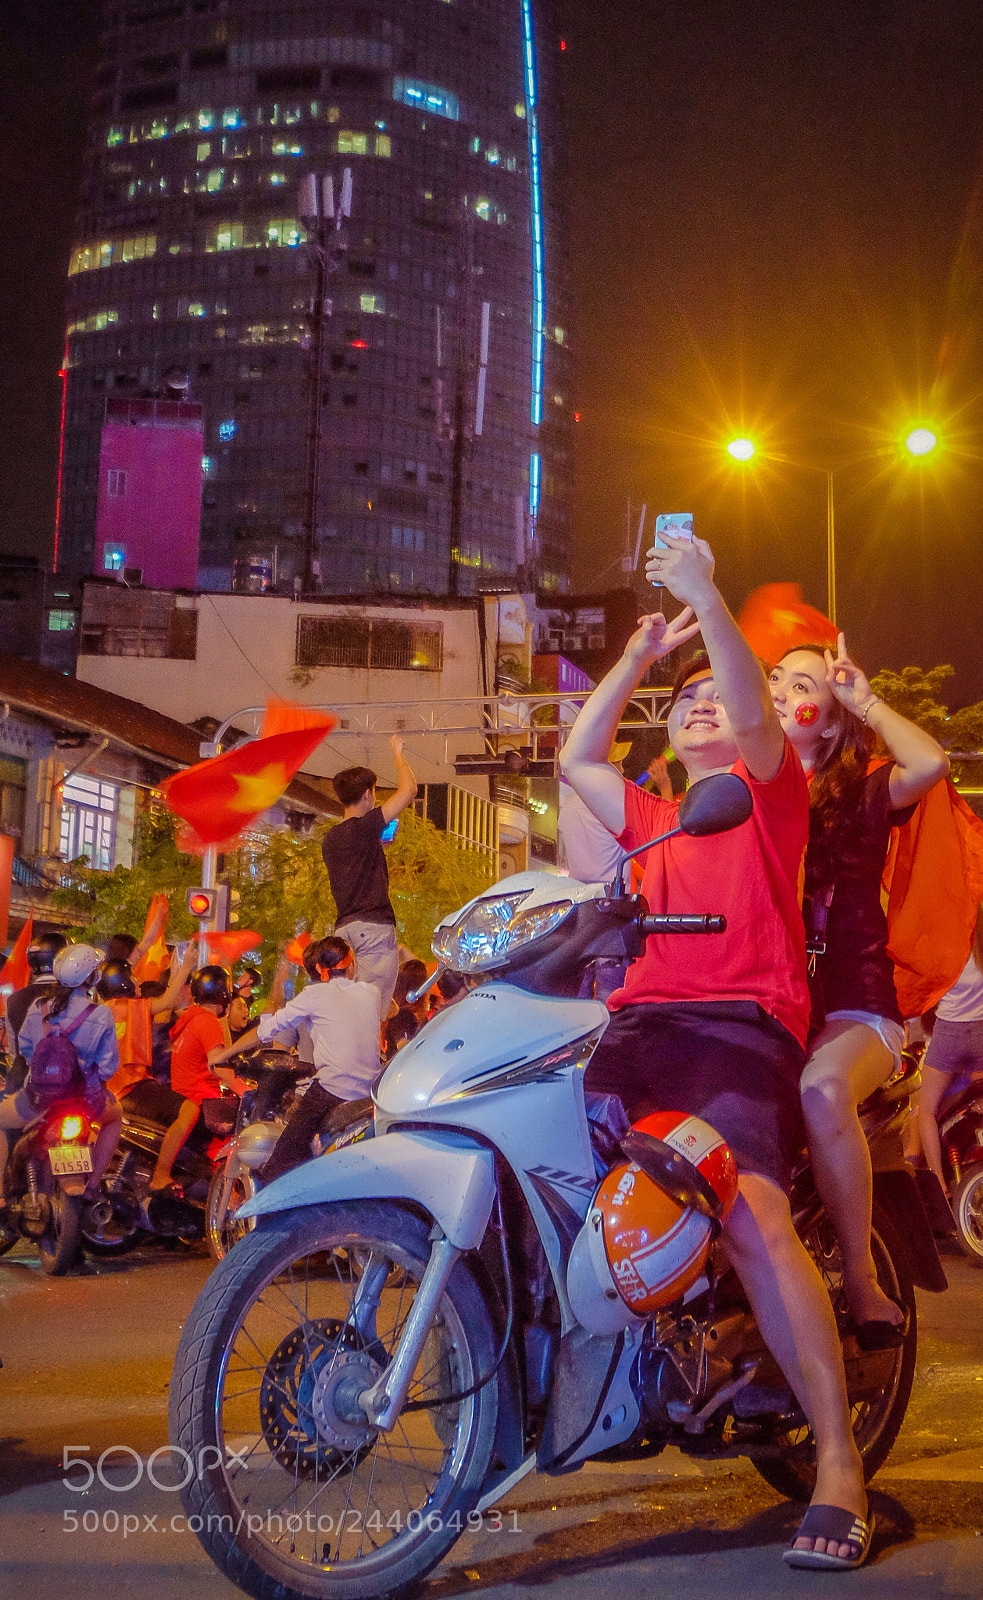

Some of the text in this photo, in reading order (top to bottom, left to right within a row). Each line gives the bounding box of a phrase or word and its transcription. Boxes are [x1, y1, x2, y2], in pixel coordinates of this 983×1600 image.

[466, 992, 497, 1001] NDA
[54, 1160, 90, 1173] 415.58
[613, 1258, 647, 1302] STAR
